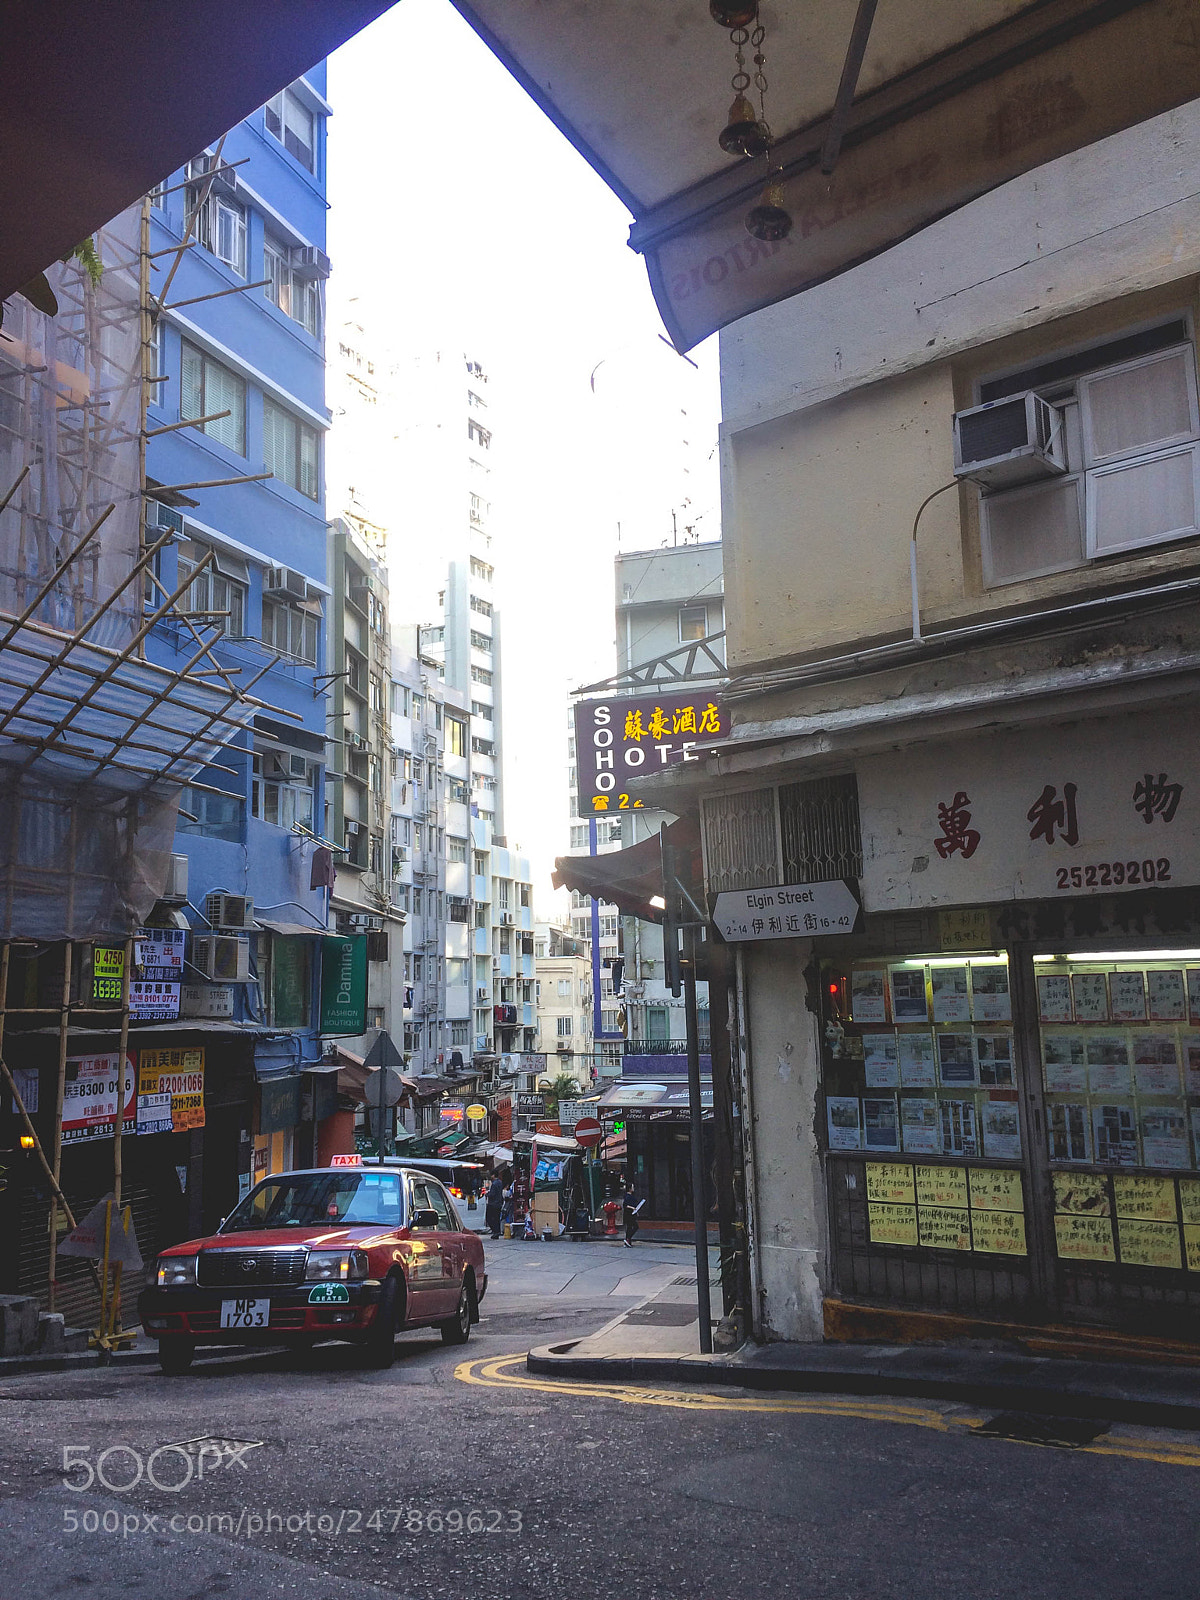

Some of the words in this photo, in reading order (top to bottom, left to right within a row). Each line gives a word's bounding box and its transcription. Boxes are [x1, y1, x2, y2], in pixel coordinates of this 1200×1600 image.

[623, 703, 721, 742] 蘇豪酒店
[747, 893, 774, 909] Elgin
[777, 889, 815, 904] Street
[752, 913, 818, 934] 伊利近街
[104, 951, 122, 964] 4750
[336, 943, 353, 1004] Damina
[210, 991, 229, 999] STREET
[80, 1083, 104, 1097] 8300
[94, 1123, 114, 1134] 2813
[334, 1156, 359, 1165] TAXI
[325, 1287, 334, 1296] 5
[236, 1300, 256, 1312] MP
[225, 1313, 264, 1326] 1703
